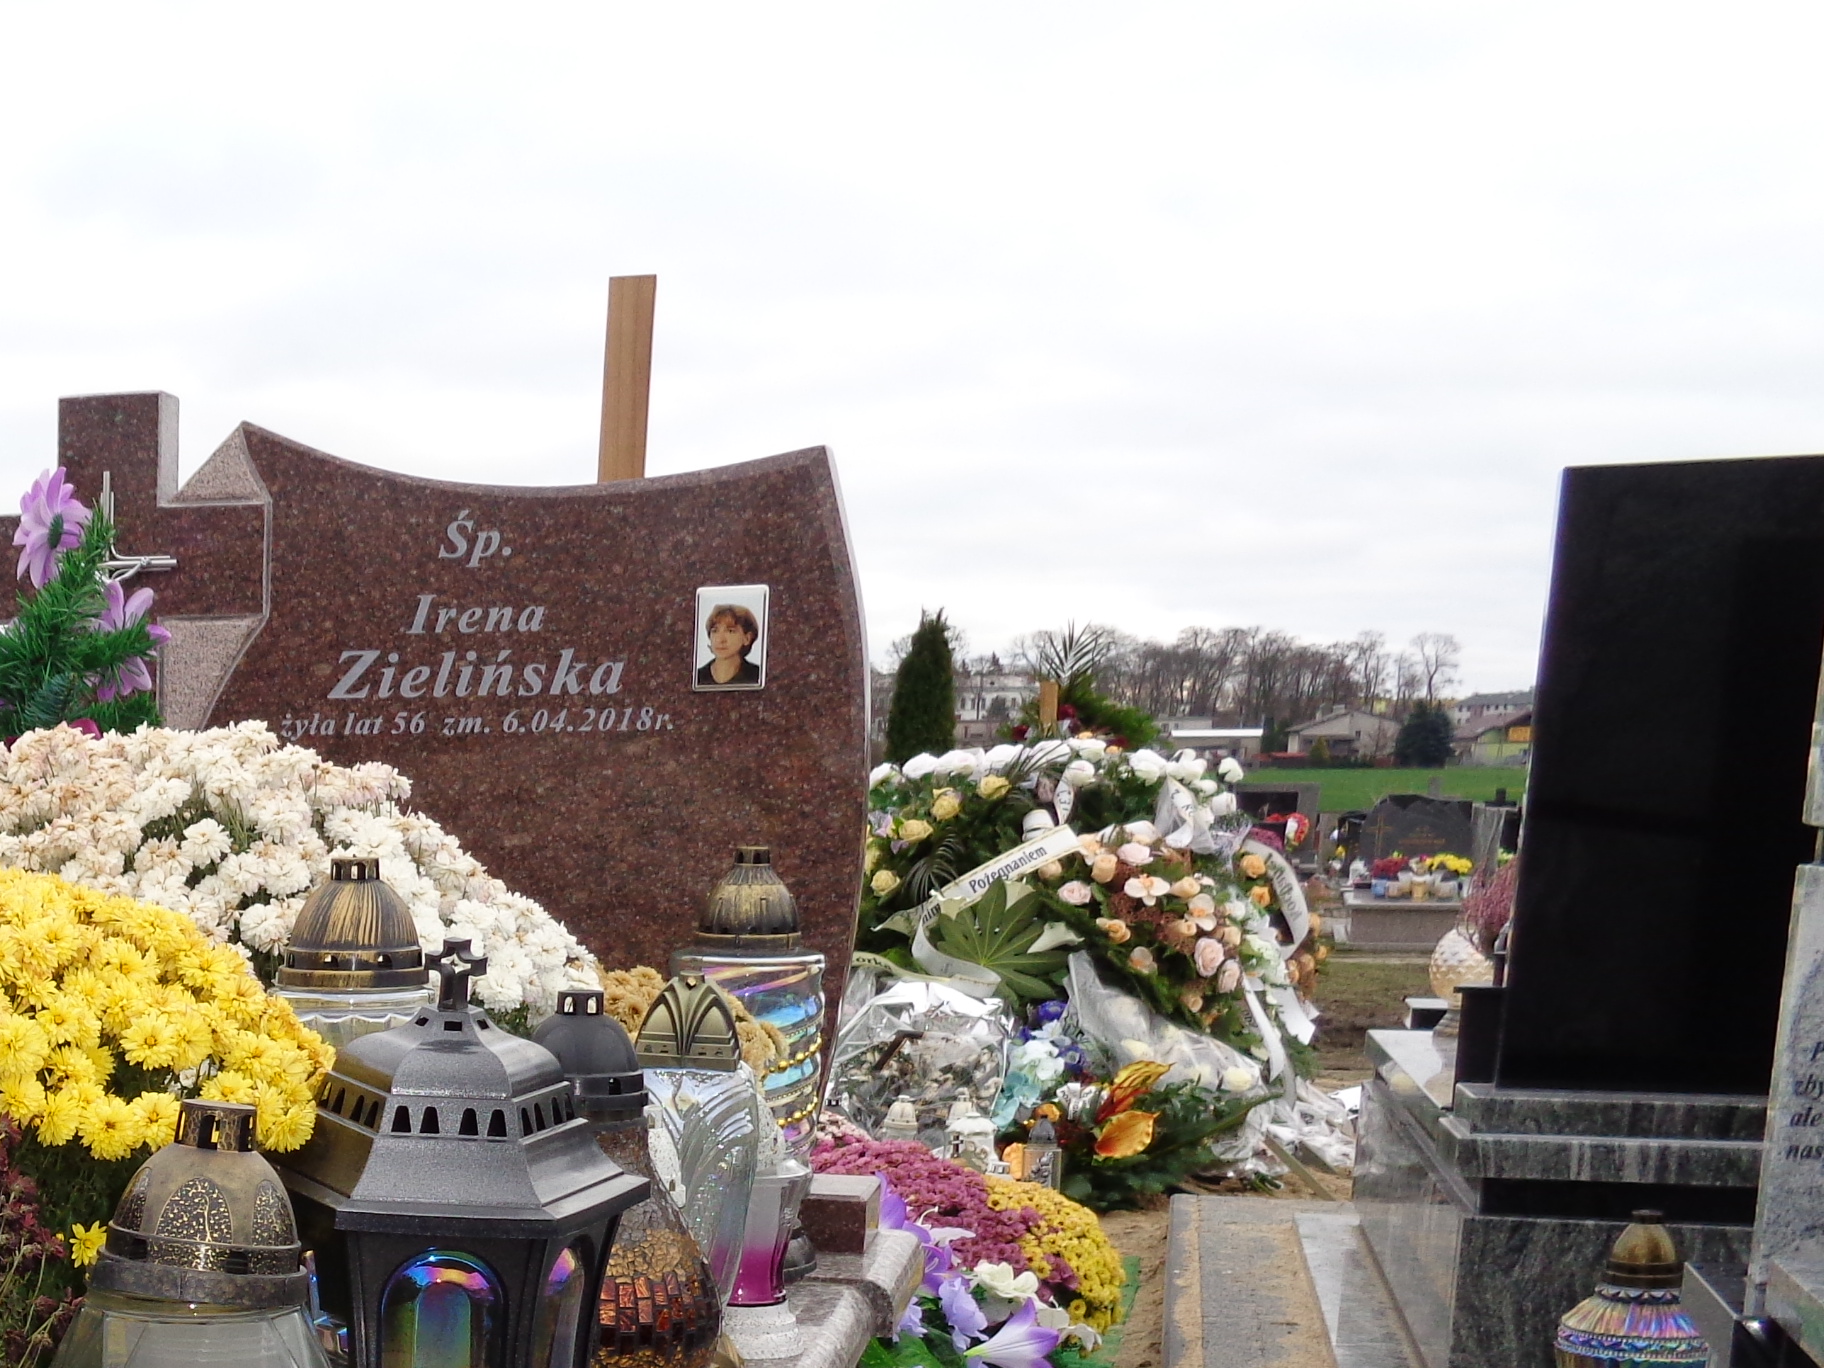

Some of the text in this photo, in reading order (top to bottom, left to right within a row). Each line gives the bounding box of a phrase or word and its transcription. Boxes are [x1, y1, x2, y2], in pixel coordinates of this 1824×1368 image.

[438, 510, 513, 568] Śp.
[406, 594, 546, 635] Irena
[326, 647, 626, 700] Zielińska
[280, 706, 675, 742] żyła lat 56 zm. 6.04.2018r.
